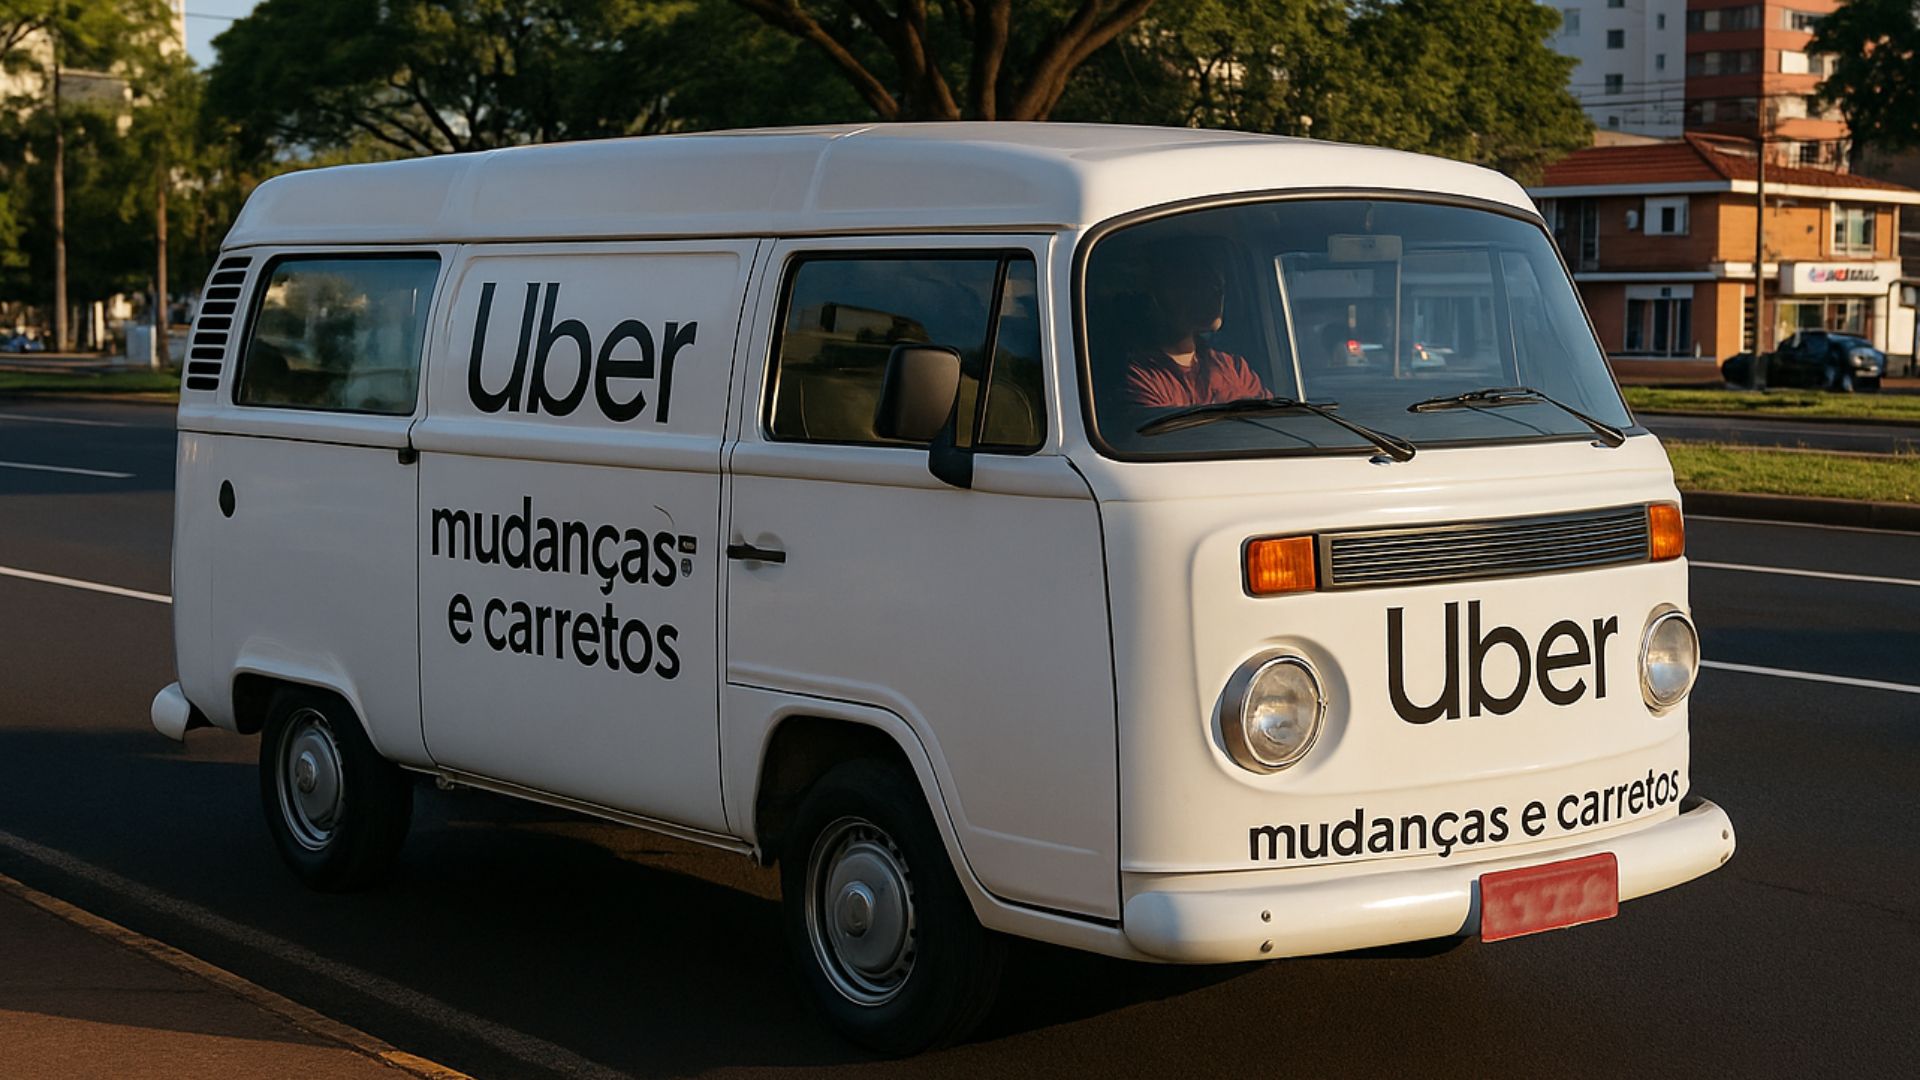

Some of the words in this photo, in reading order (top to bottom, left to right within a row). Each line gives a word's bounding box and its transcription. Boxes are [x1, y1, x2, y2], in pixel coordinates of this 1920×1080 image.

[468, 282, 697, 424] Uber
[432, 496, 677, 596] mudanças
[448, 594, 473, 644] e
[484, 602, 681, 679] carretos
[1386, 600, 1618, 724] Uber
[1250, 808, 1509, 860] mudanças
[1521, 802, 1546, 836] e
[1557, 769, 1679, 829] carretos
